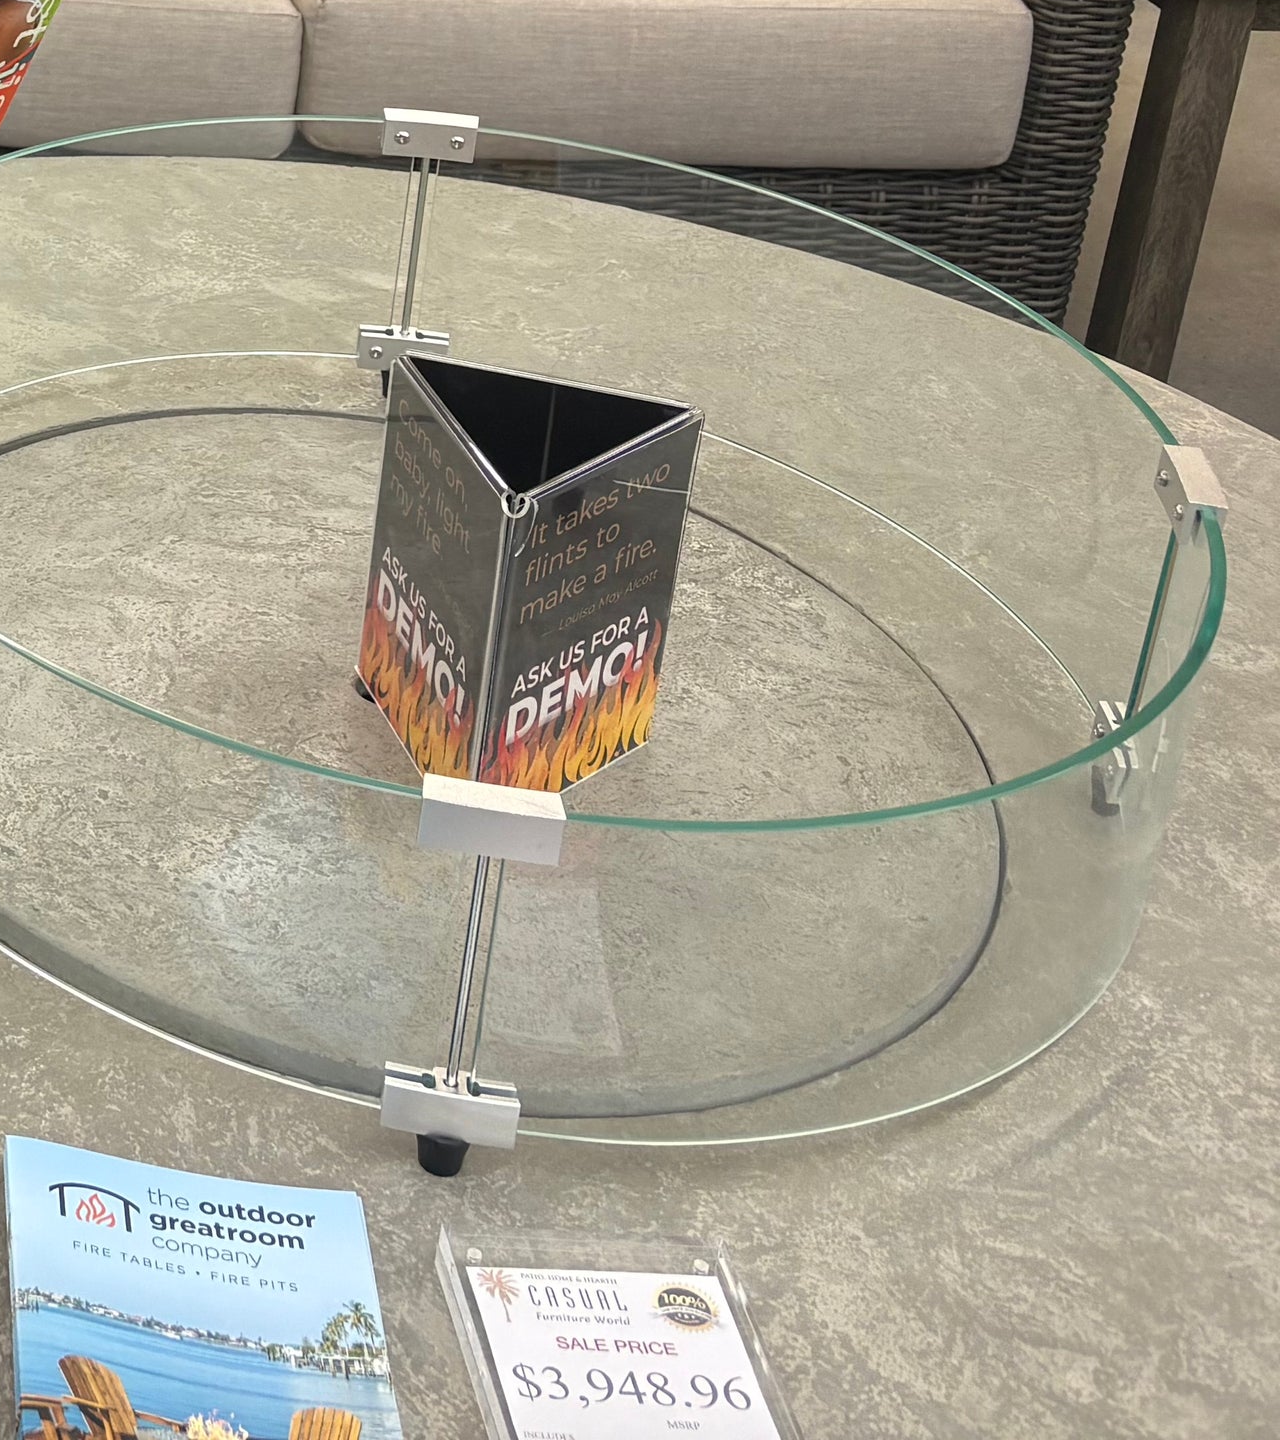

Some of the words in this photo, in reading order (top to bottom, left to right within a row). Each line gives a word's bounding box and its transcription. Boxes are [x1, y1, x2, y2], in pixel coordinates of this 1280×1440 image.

[398, 398, 441, 469] Come
[391, 474, 414, 517] my
[394, 432, 432, 506] baby,
[436, 487, 471, 555] light
[531, 521, 549, 550] It
[556, 488, 620, 537] takes
[626, 462, 672, 500] two
[519, 574, 588, 626] make
[593, 563, 608, 586] a
[615, 538, 658, 574] fire.
[525, 538, 589, 588] flints
[596, 523, 622, 550] to
[382, 546, 408, 594] ASK
[409, 582, 428, 621] US
[428, 609, 456, 664] FOR
[456, 655, 467, 683] A
[376, 568, 466, 728] DEMO!
[511, 656, 555, 699] ASK
[559, 639, 587, 670] US
[590, 615, 632, 655] FOR
[634, 606, 650, 631] A
[505, 629, 650, 747] DEMO!
[146, 1186, 191, 1213] the
[198, 1198, 317, 1230] outdoor
[149, 1212, 306, 1251] greatroom
[72, 1239, 113, 1259] FIRE
[121, 1251, 188, 1276] TABLES
[210, 1270, 252, 1288] FIRE
[258, 1277, 300, 1294] PITS
[151, 1233, 264, 1270] company
[527, 1284, 628, 1312] CASUAL
[536, 1311, 592, 1324] Furniture
[594, 1315, 631, 1327] World
[660, 1292, 707, 1310] 100%
[555, 1335, 610, 1354] SALE
[614, 1338, 679, 1357] PRICE
[511, 1361, 753, 1412] $3,948.96
[666, 1418, 702, 1432] MSRP
